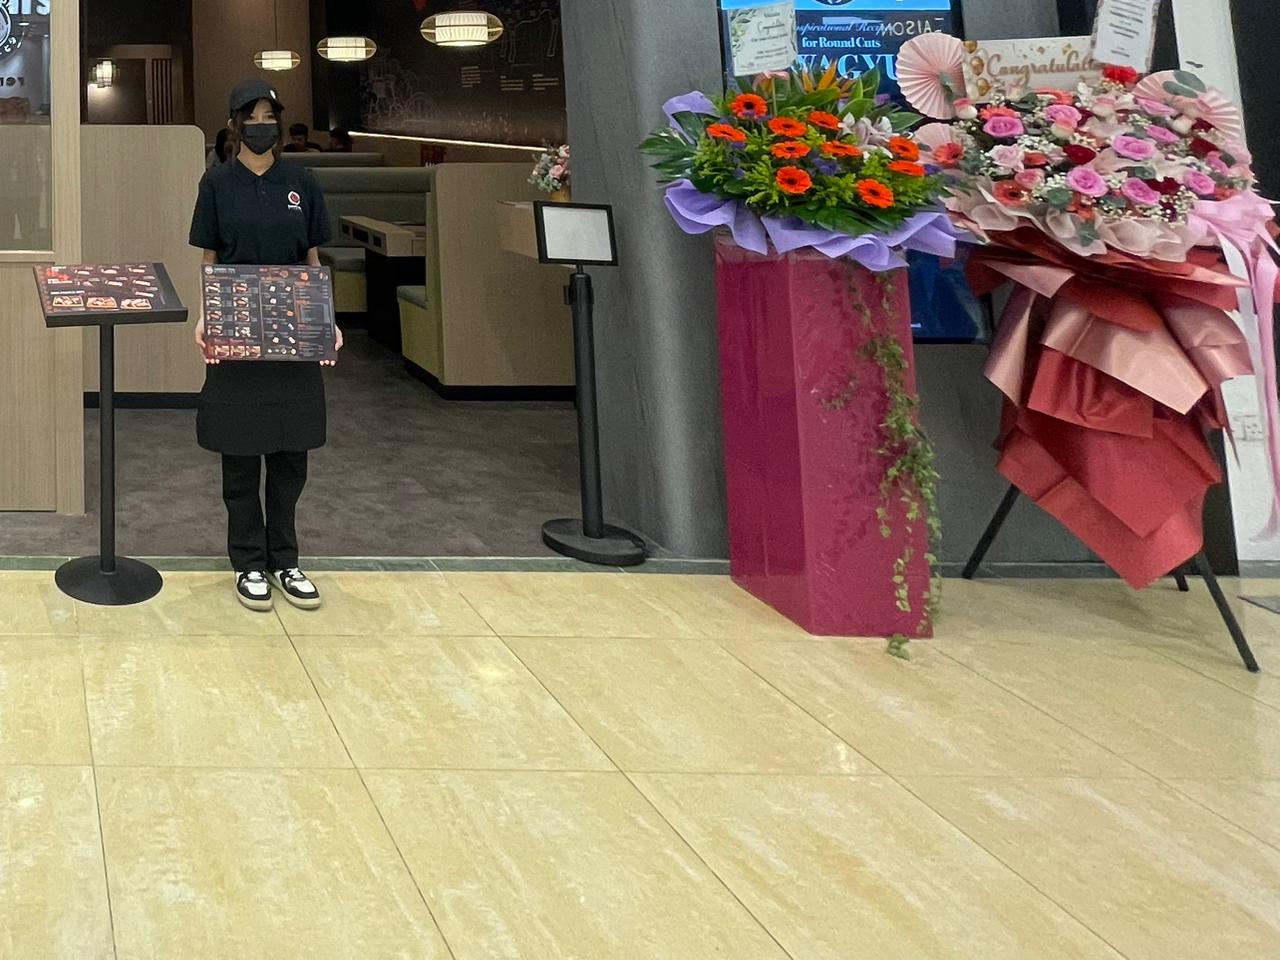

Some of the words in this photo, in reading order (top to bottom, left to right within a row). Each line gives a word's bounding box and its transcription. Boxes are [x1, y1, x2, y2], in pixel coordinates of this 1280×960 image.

[802, 37, 818, 48] for
[819, 37, 855, 48] Round
[856, 37, 881, 48] Cuts
